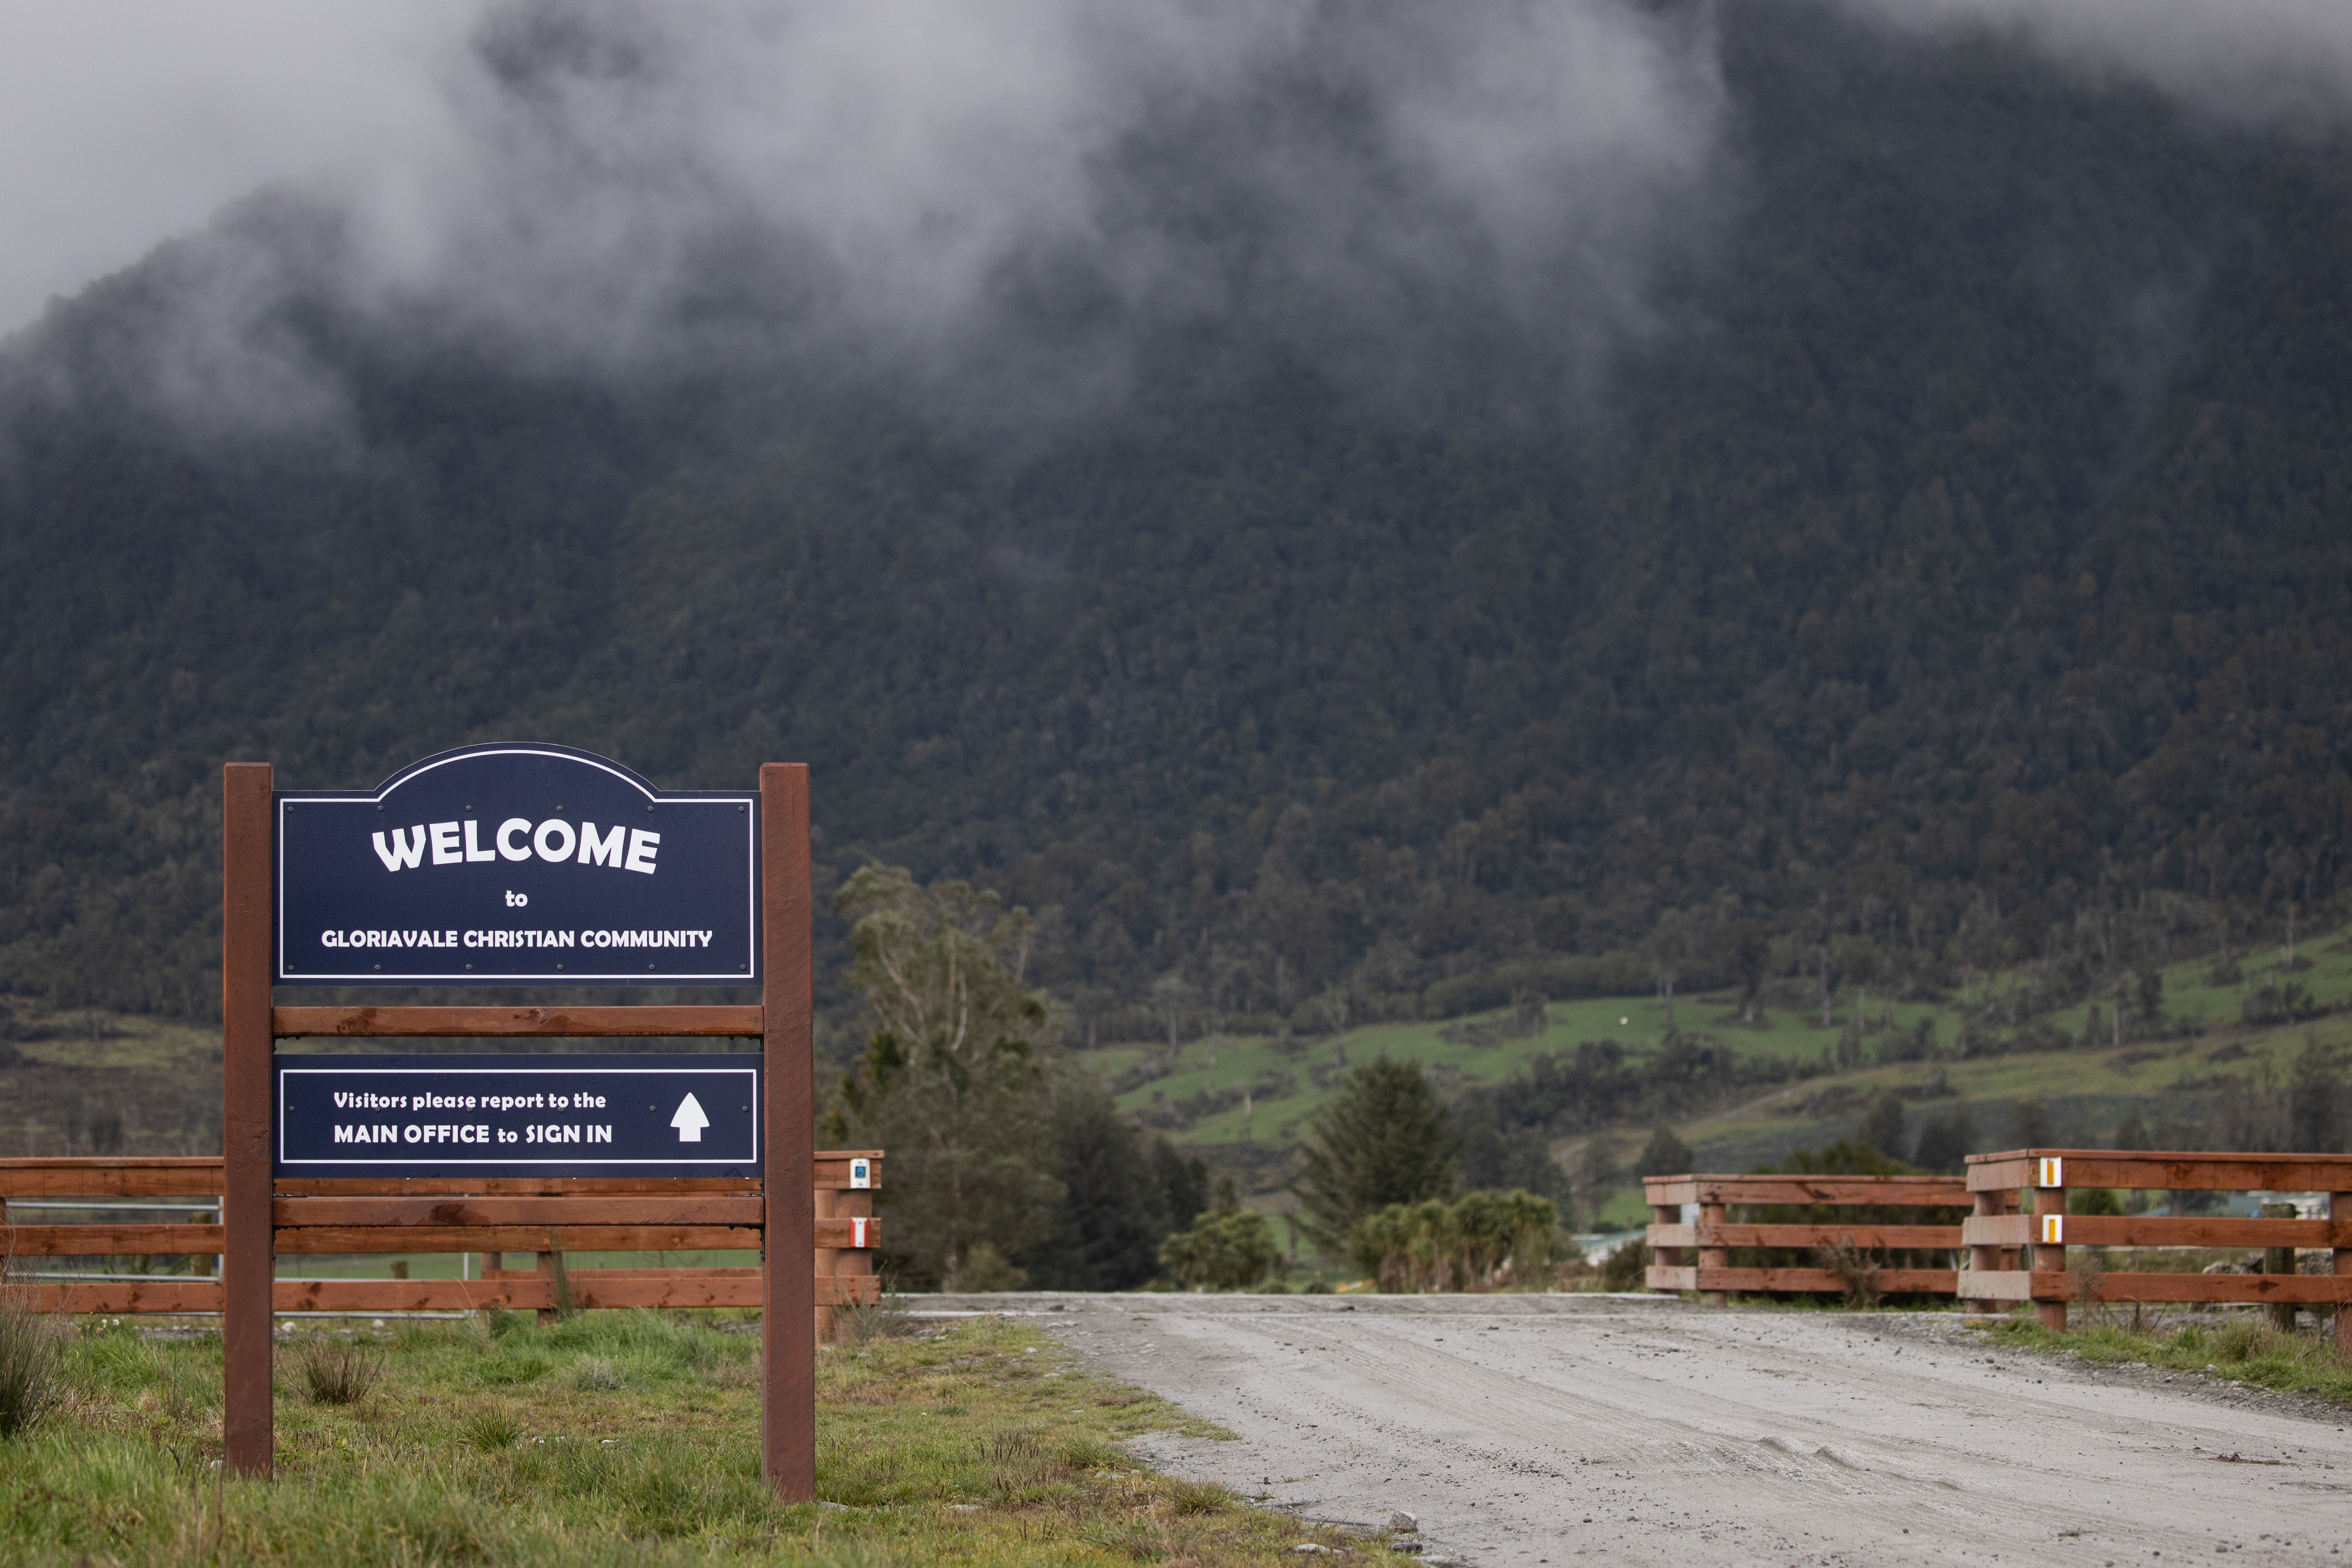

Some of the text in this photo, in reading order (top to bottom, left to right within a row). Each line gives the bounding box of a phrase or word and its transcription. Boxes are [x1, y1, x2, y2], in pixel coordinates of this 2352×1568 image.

[372, 818, 661, 874] WELCOME
[505, 890, 528, 907] to
[321, 930, 713, 948] GLORIAVALE CHRISTIAN COMMUNITY
[334, 1092, 606, 1111] Visitors please report to the
[334, 1124, 612, 1143] MAIN OFFICE to SIGN IN
